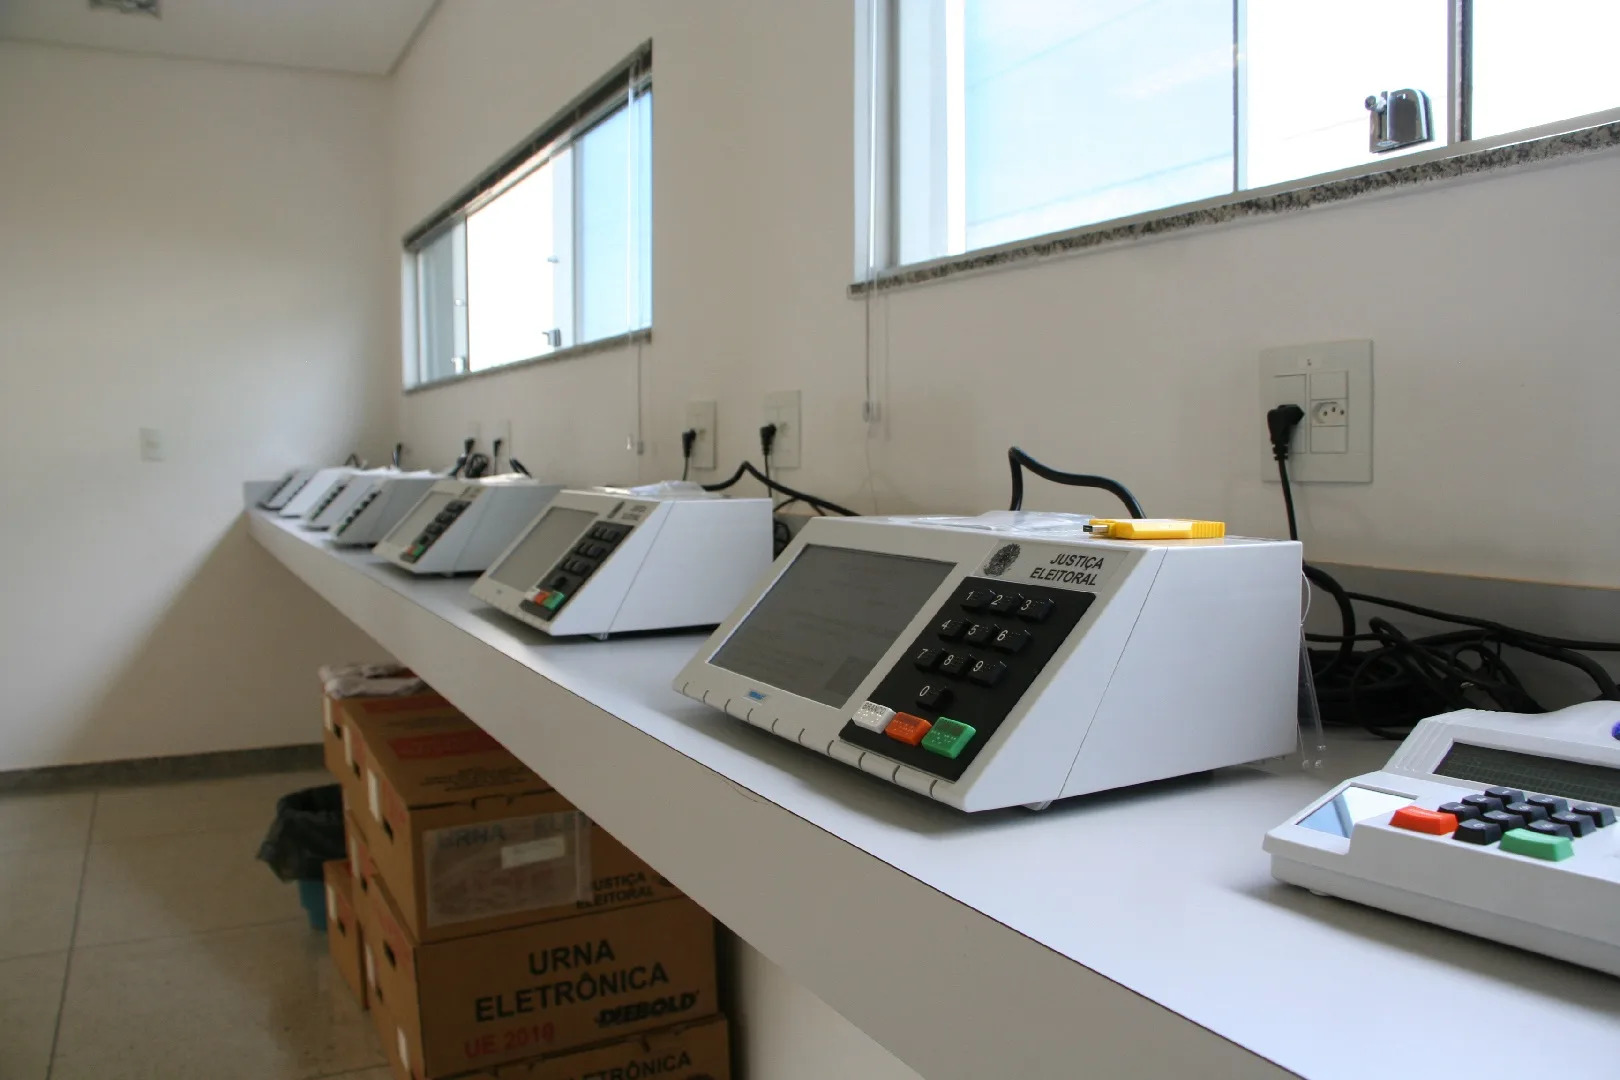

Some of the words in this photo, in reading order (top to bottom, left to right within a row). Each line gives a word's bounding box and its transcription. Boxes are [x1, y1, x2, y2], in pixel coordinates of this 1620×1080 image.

[1050, 553, 1104, 570] JUSTIÇA
[1030, 567, 1097, 586] ELEITORAL
[966, 590, 974, 601] 1
[991, 594, 1003, 605] 2
[1021, 600, 1031, 611] 3
[941, 619, 951, 630] 4
[967, 624, 979, 635] 5
[997, 629, 1008, 641] 6
[917, 648, 928, 659] 7
[944, 654, 954, 666] 8
[973, 660, 984, 672] 9
[919, 685, 930, 697] 0
[591, 871, 646, 891] USTIÇA
[528, 939, 615, 976] URNA
[475, 962, 669, 1022] ELETRÔNICA
[464, 1034, 496, 1058] UE
